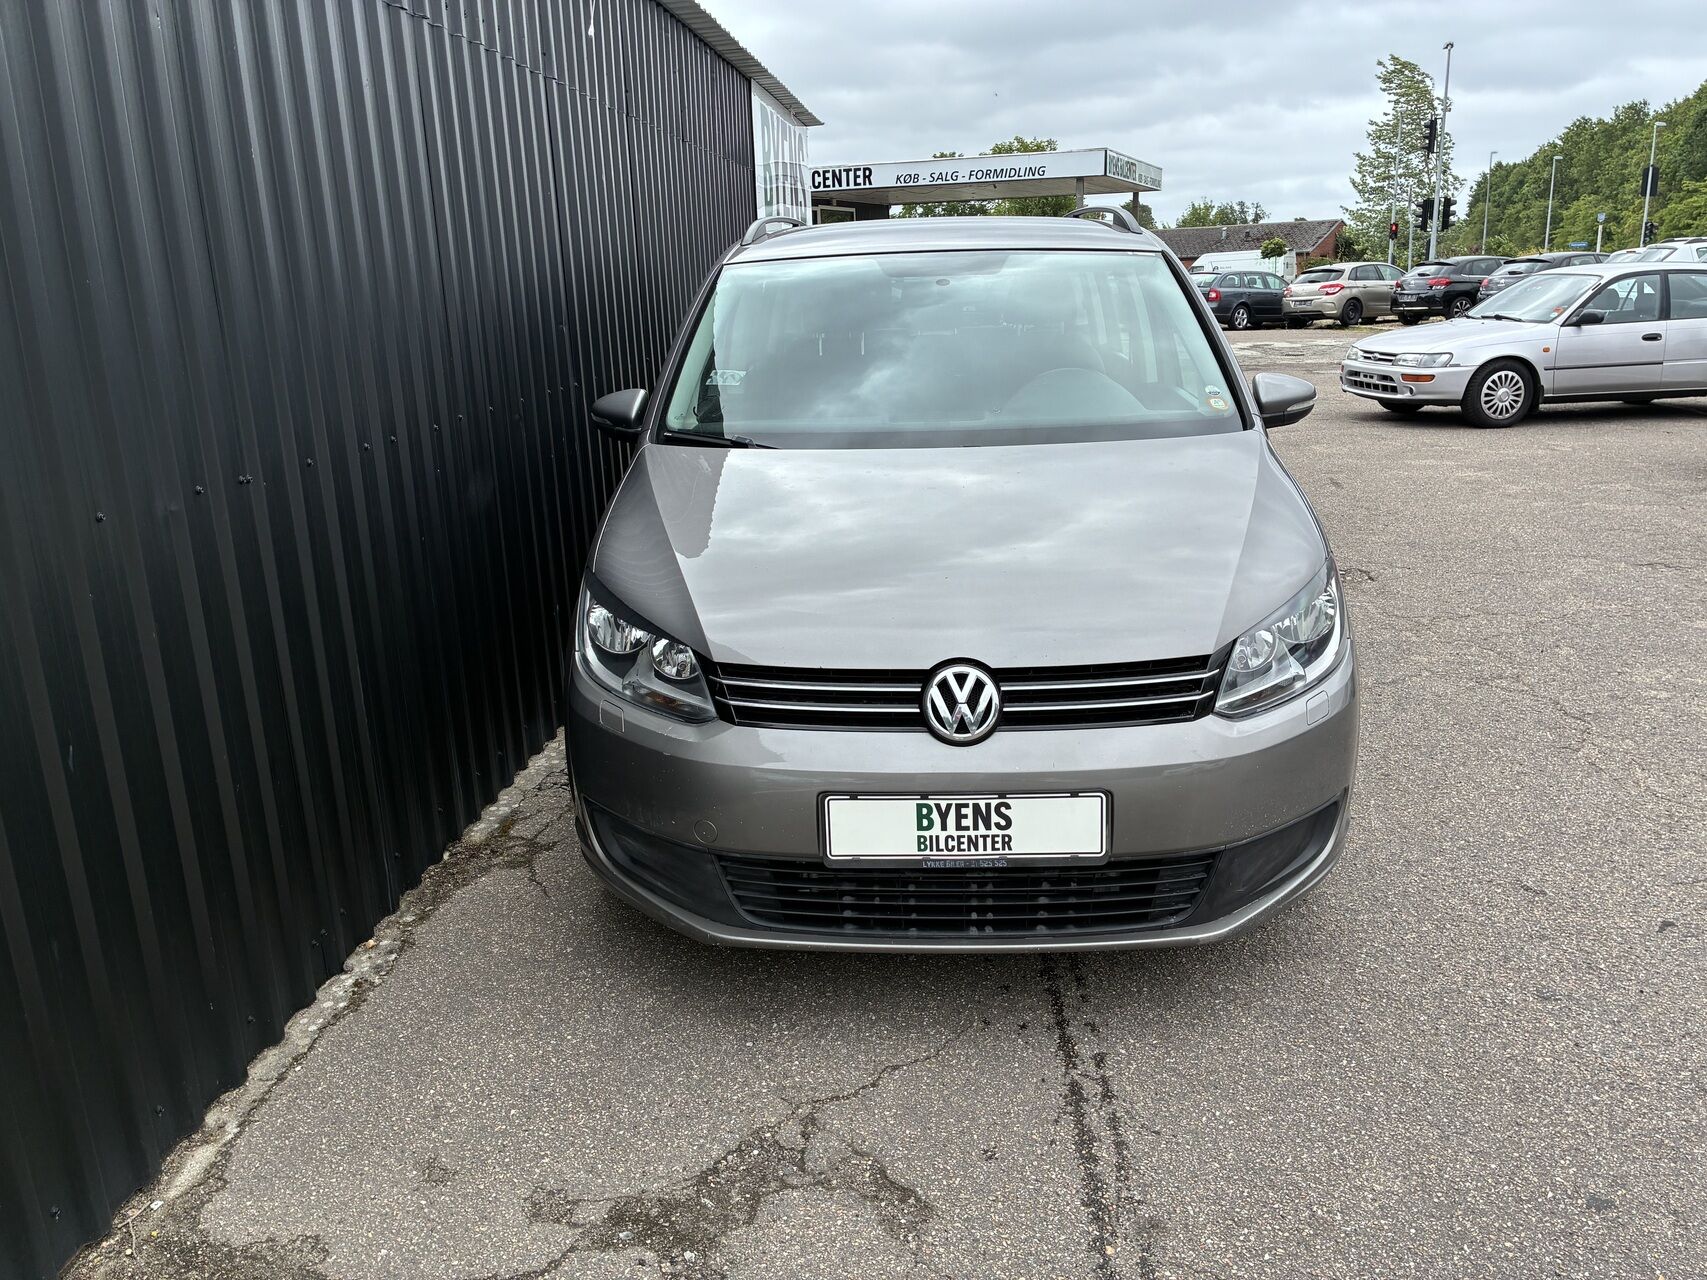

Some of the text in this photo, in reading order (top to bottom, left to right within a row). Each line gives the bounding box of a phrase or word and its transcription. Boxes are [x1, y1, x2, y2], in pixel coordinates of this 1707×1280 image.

[811, 167, 873, 190] CENTER
[895, 173, 920, 185] KØB
[929, 170, 960, 183] SALG
[968, 165, 1047, 181] FORMIDLING
[916, 801, 1013, 832] BYENS
[917, 833, 1013, 853] BILCENTER
